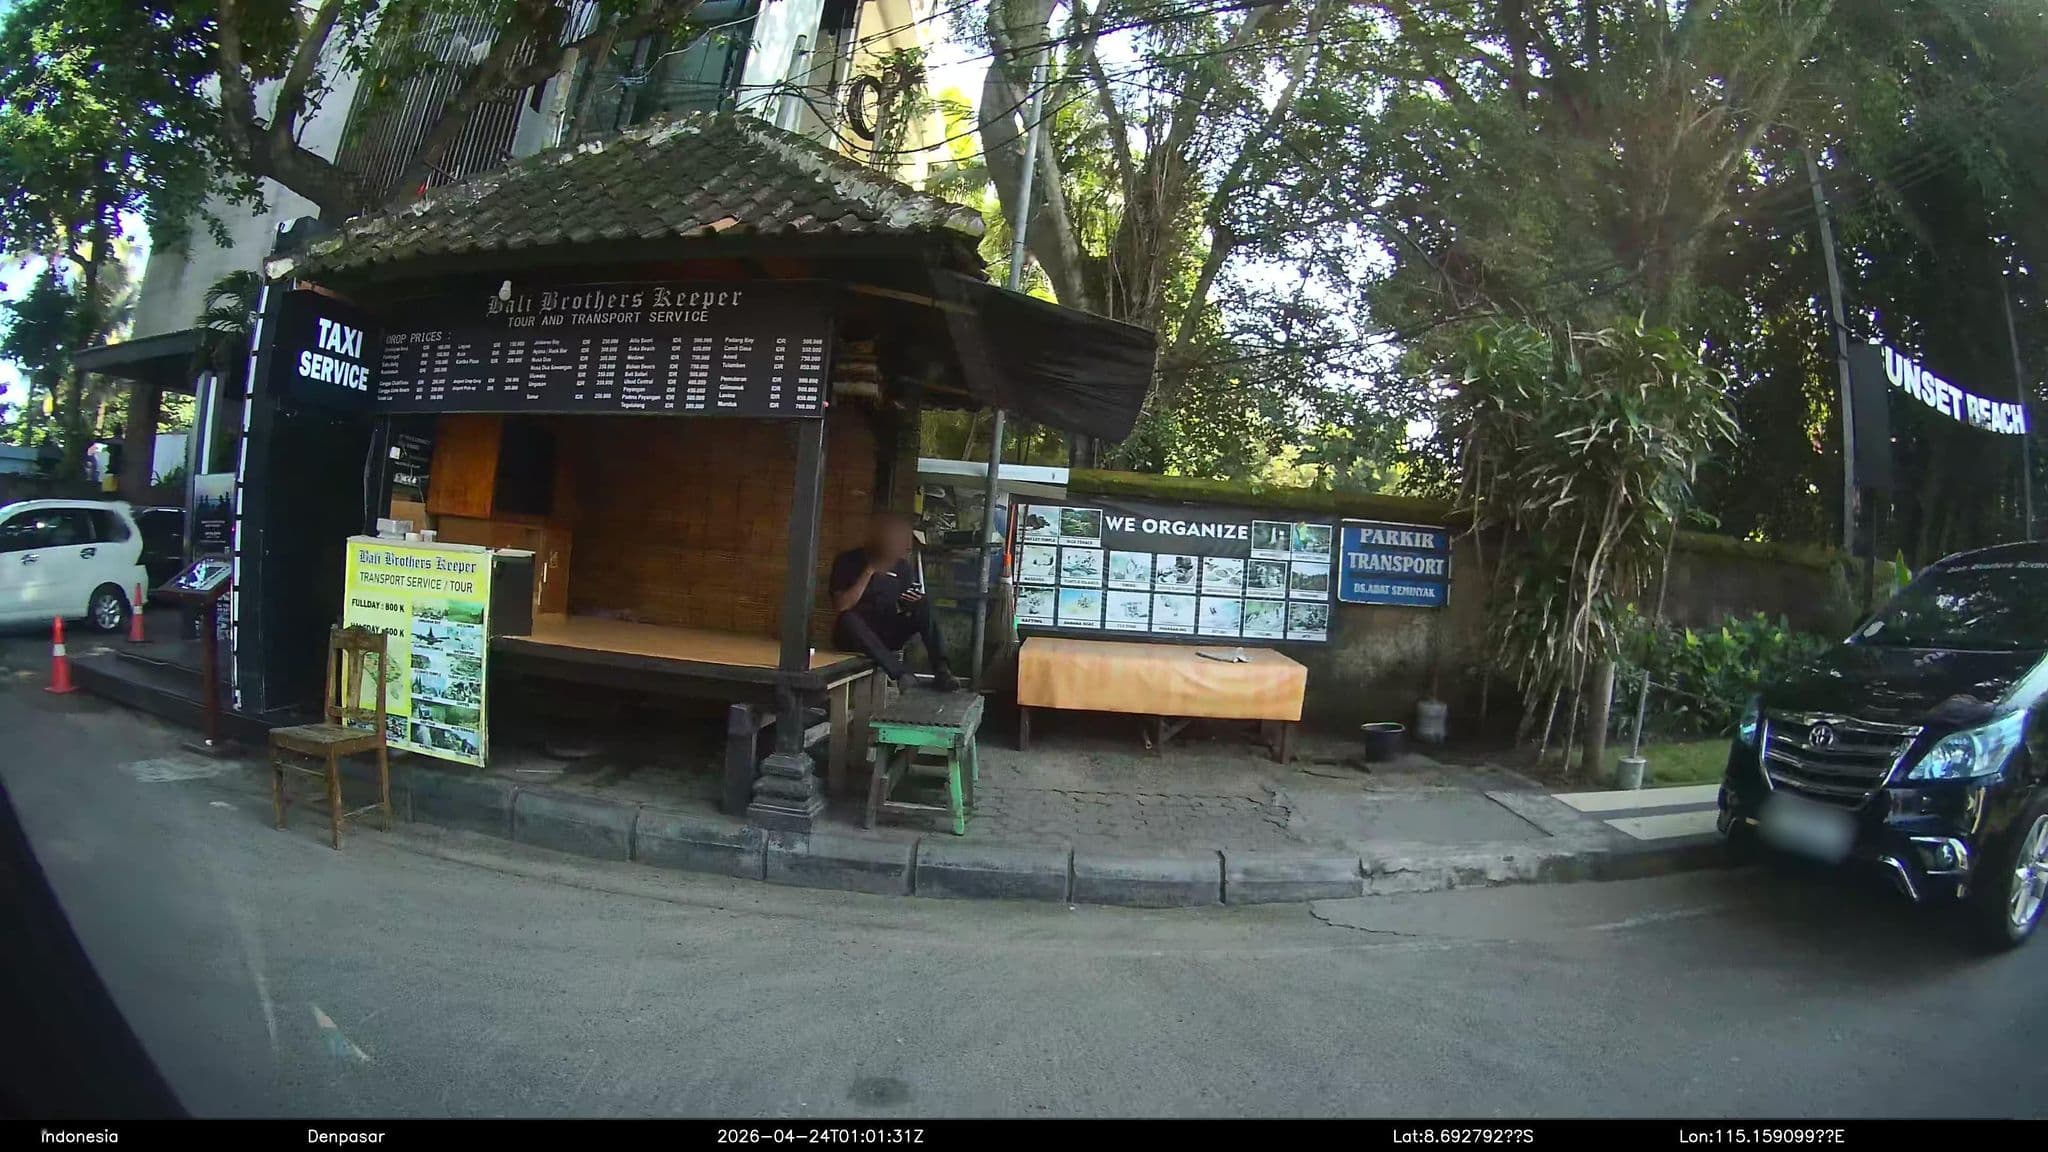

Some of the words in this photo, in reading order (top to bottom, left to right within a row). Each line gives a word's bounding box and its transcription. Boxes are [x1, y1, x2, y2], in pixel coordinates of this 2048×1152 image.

[486, 295, 532, 317] Bali
[539, 290, 644, 312] Brothers
[652, 287, 742, 309] Keeper
[508, 315, 536, 328] TOUR
[541, 314, 564, 326] AND
[571, 312, 642, 324] TRANSPORT
[648, 310, 709, 322] SERVICE
[318, 317, 364, 358] TAXI
[386, 334, 407, 344] DROP
[410, 331, 442, 343] PRICES
[298, 350, 370, 391] SERVICE
[1881, 346, 1963, 421] UNSET
[1966, 394, 2026, 434] BEACH
[1104, 516, 1136, 532] WE
[1141, 518, 1249, 540] ORGANIZE
[1360, 528, 1434, 548] PARKIR
[360, 550, 380, 564] Bali
[384, 552, 432, 569] Brothers
[436, 556, 476, 574] Keeper
[1347, 552, 1444, 576] TRANSPORT
[360, 572, 405, 586] TRANSPORT
[406, 576, 440, 589] SERVICE
[450, 581, 472, 592] TOUR
[352, 598, 380, 609] FULLDAY
[385, 603, 398, 611] 800
